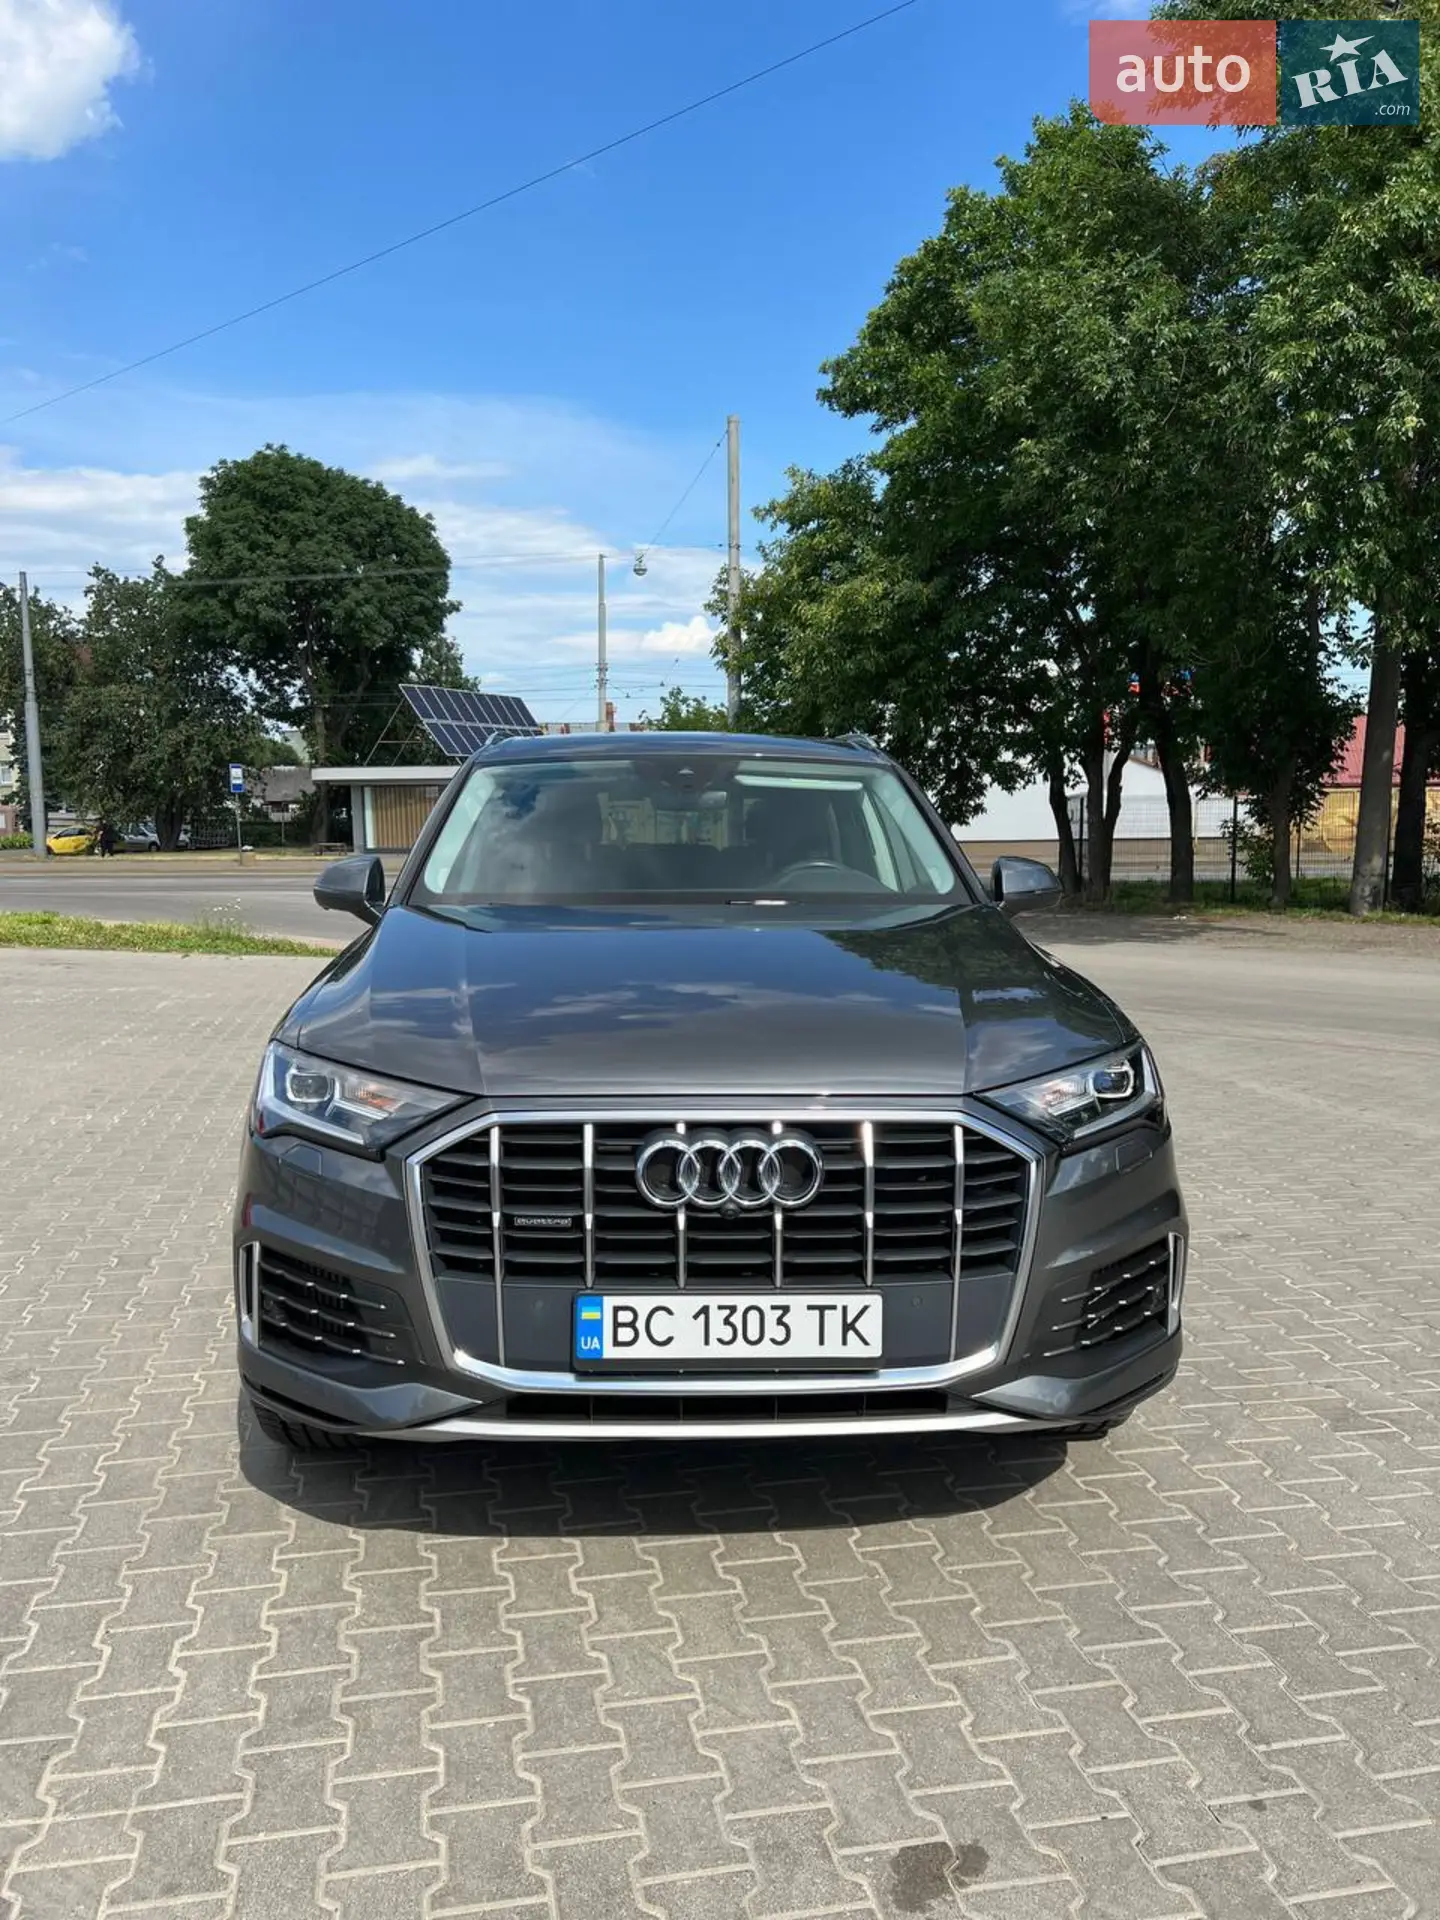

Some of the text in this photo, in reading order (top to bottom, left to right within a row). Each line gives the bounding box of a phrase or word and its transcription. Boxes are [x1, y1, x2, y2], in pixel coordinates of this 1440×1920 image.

[612, 1304, 871, 1348] BC 1303 TK
[581, 1336, 600, 1350] UA
